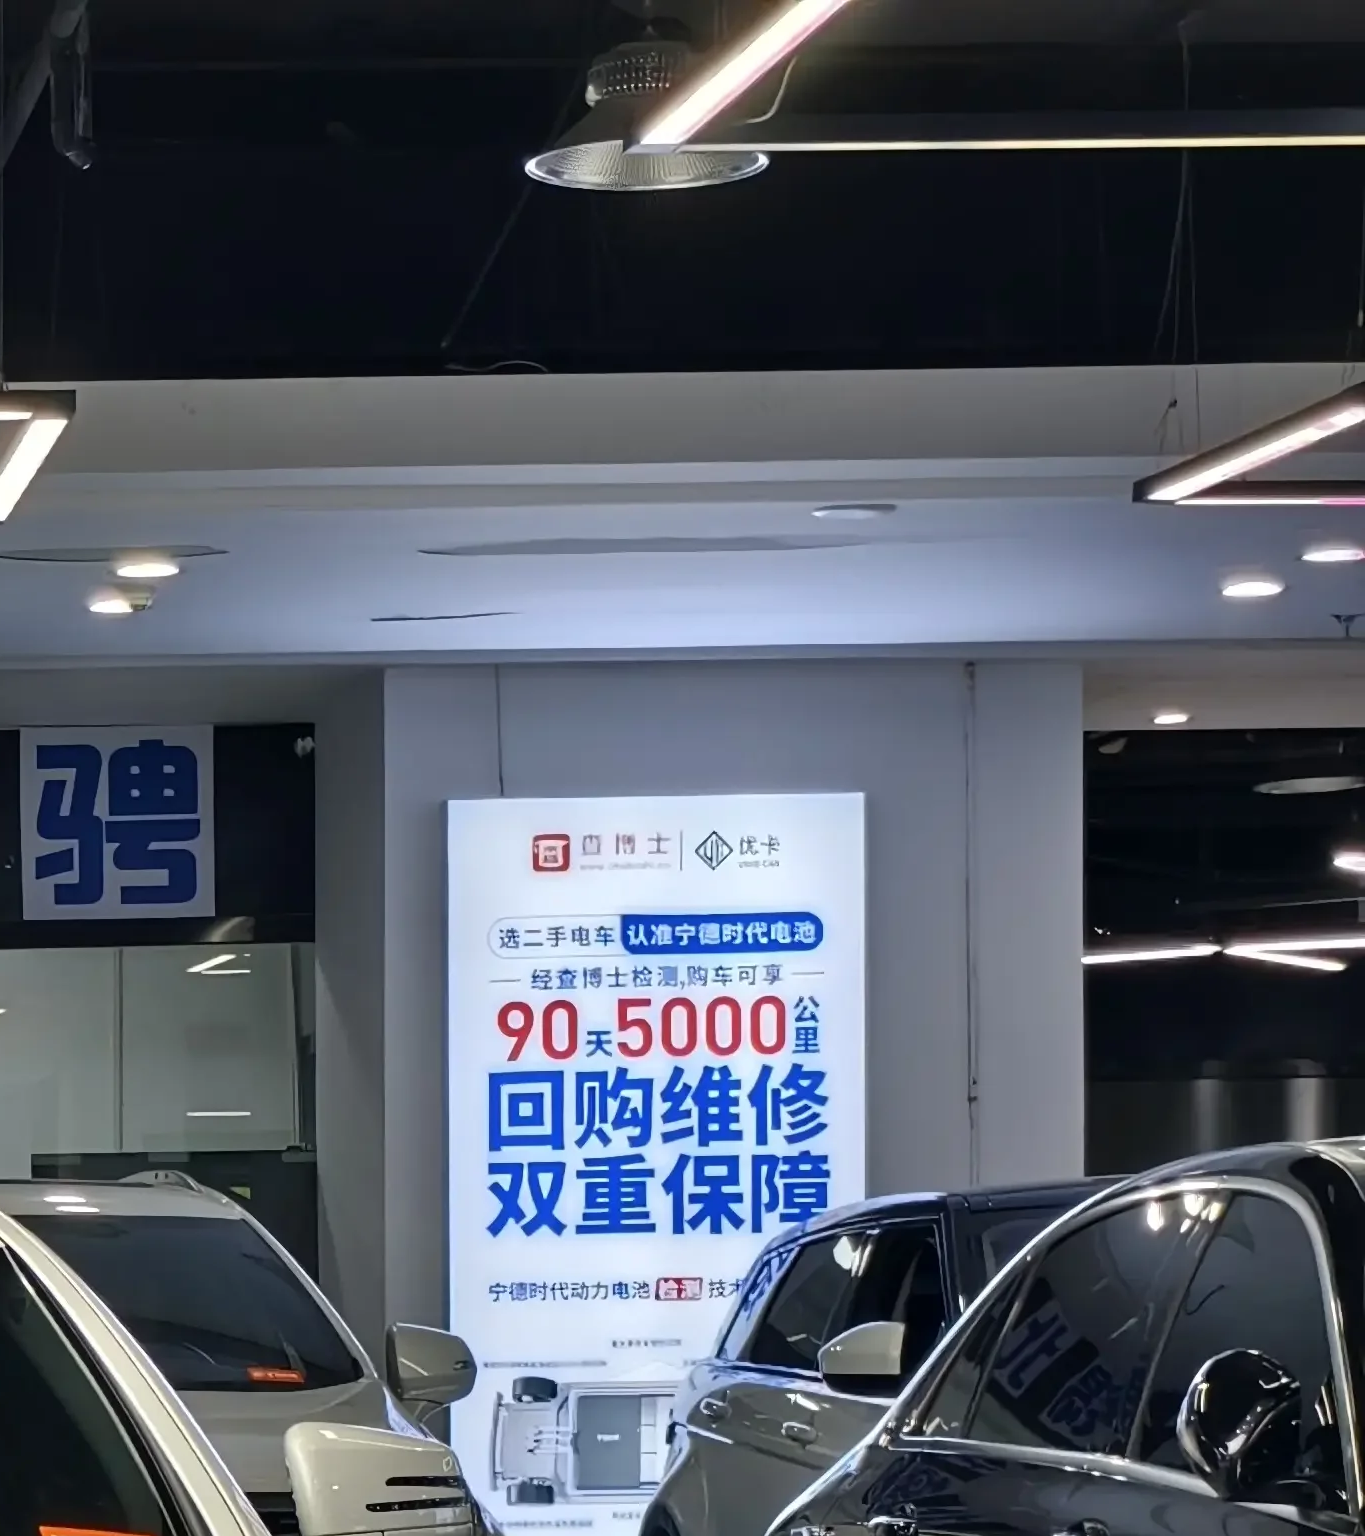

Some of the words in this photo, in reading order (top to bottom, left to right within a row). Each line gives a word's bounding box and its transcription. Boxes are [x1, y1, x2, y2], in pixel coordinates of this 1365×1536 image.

[498, 925, 616, 949] 选二手电车
[626, 920, 817, 946] 认准宁德时代电池
[488, 1063, 829, 1151] 回购维修
[486, 1150, 830, 1238] 双重保障
[488, 1280, 650, 1303] 宁德时代动力电池
